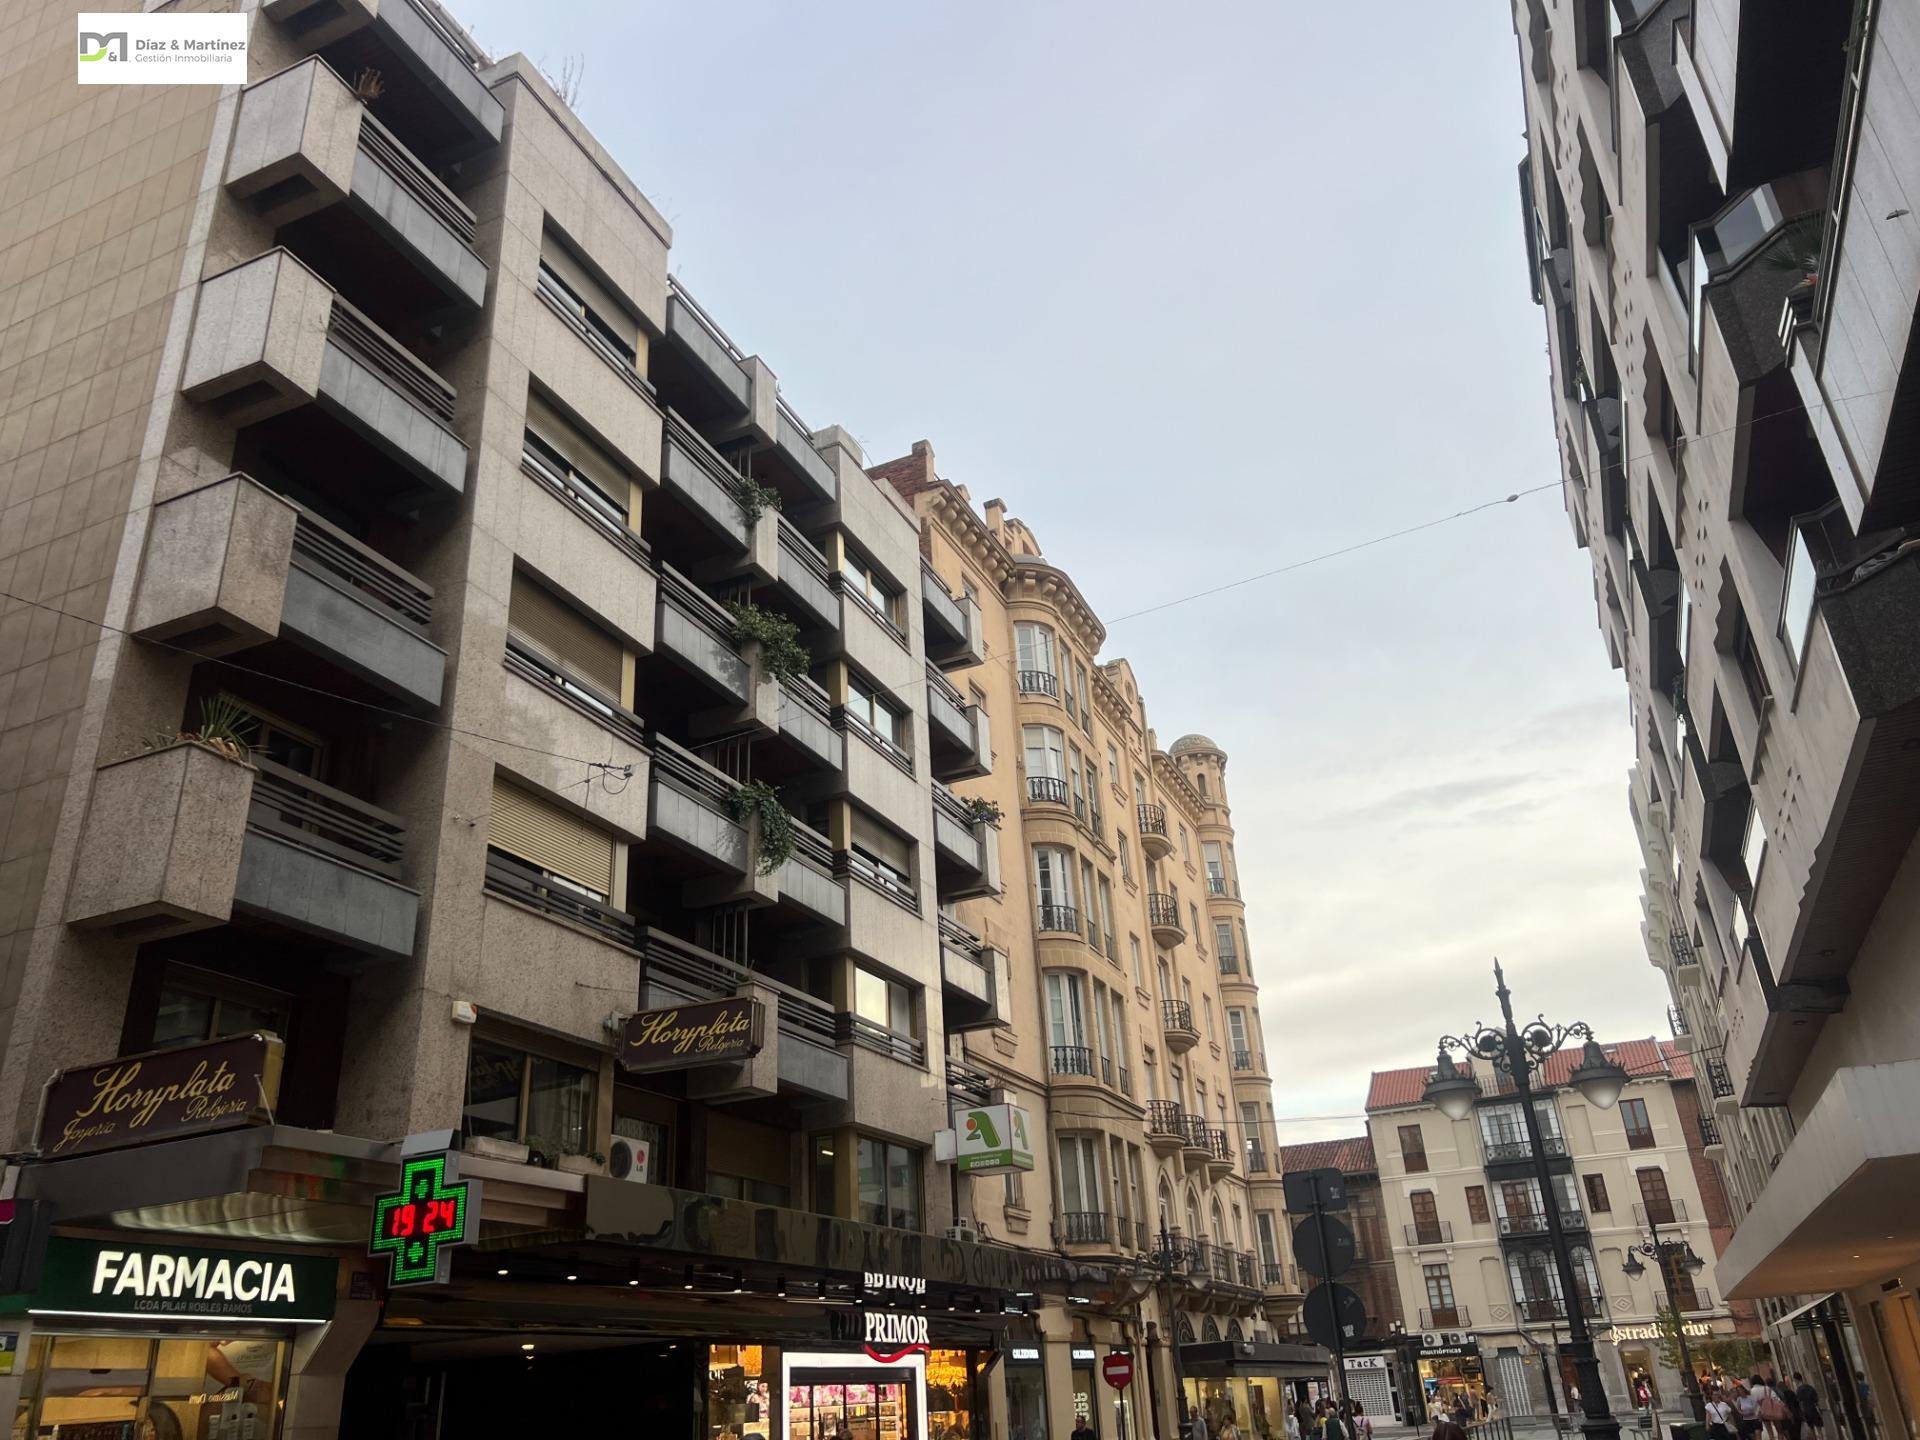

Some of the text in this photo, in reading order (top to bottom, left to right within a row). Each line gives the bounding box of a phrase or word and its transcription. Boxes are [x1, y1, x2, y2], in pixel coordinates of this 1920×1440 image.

[92, 1250, 295, 1303] FARMACIA
[161, 1301, 187, 1312] PILAR
[188, 1302, 222, 1313] ROBLES
[223, 1303, 253, 1314] RAMOS
[864, 1312, 930, 1344] PRIMOR
